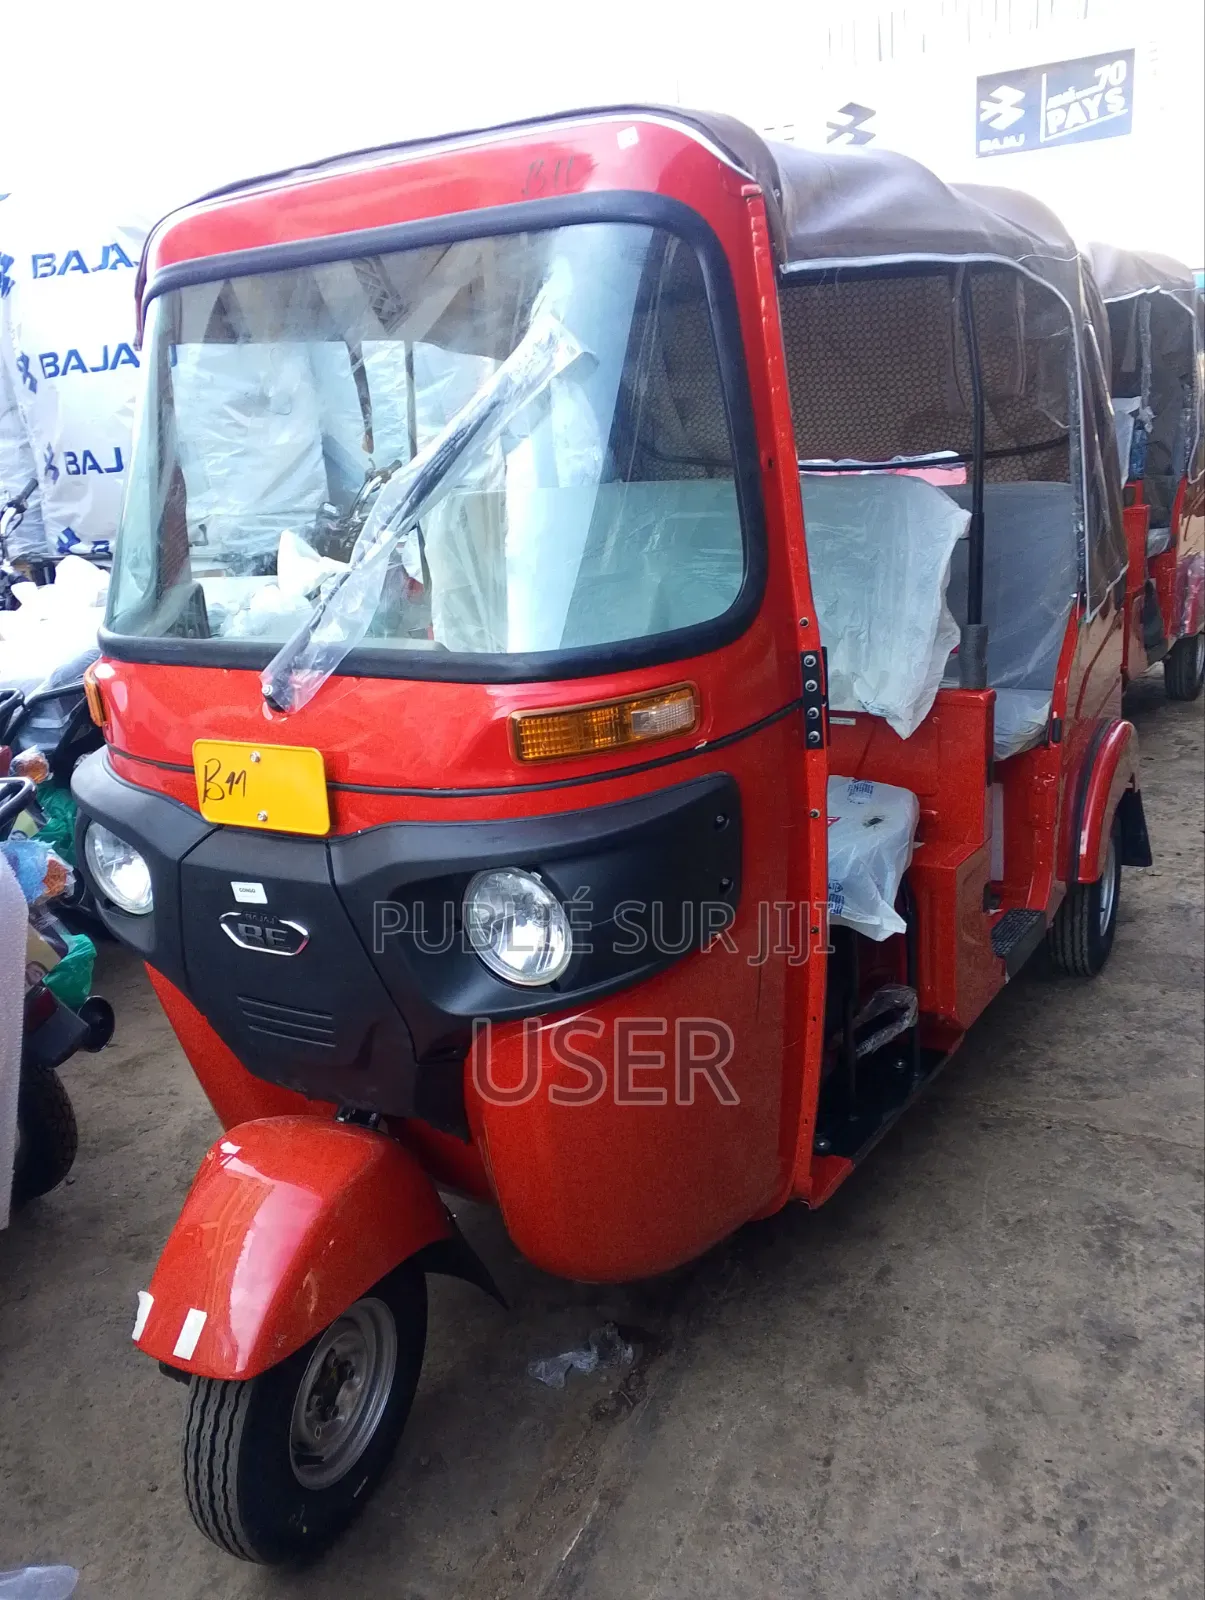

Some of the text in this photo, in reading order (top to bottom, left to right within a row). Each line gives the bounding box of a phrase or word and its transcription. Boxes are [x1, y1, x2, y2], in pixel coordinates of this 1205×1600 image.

[1094, 60, 1127, 92] 70
[1046, 87, 1126, 134] PAYS
[32, 243, 140, 279] BAJA
[63, 446, 124, 476] BAJ
[237, 923, 292, 950] RE
